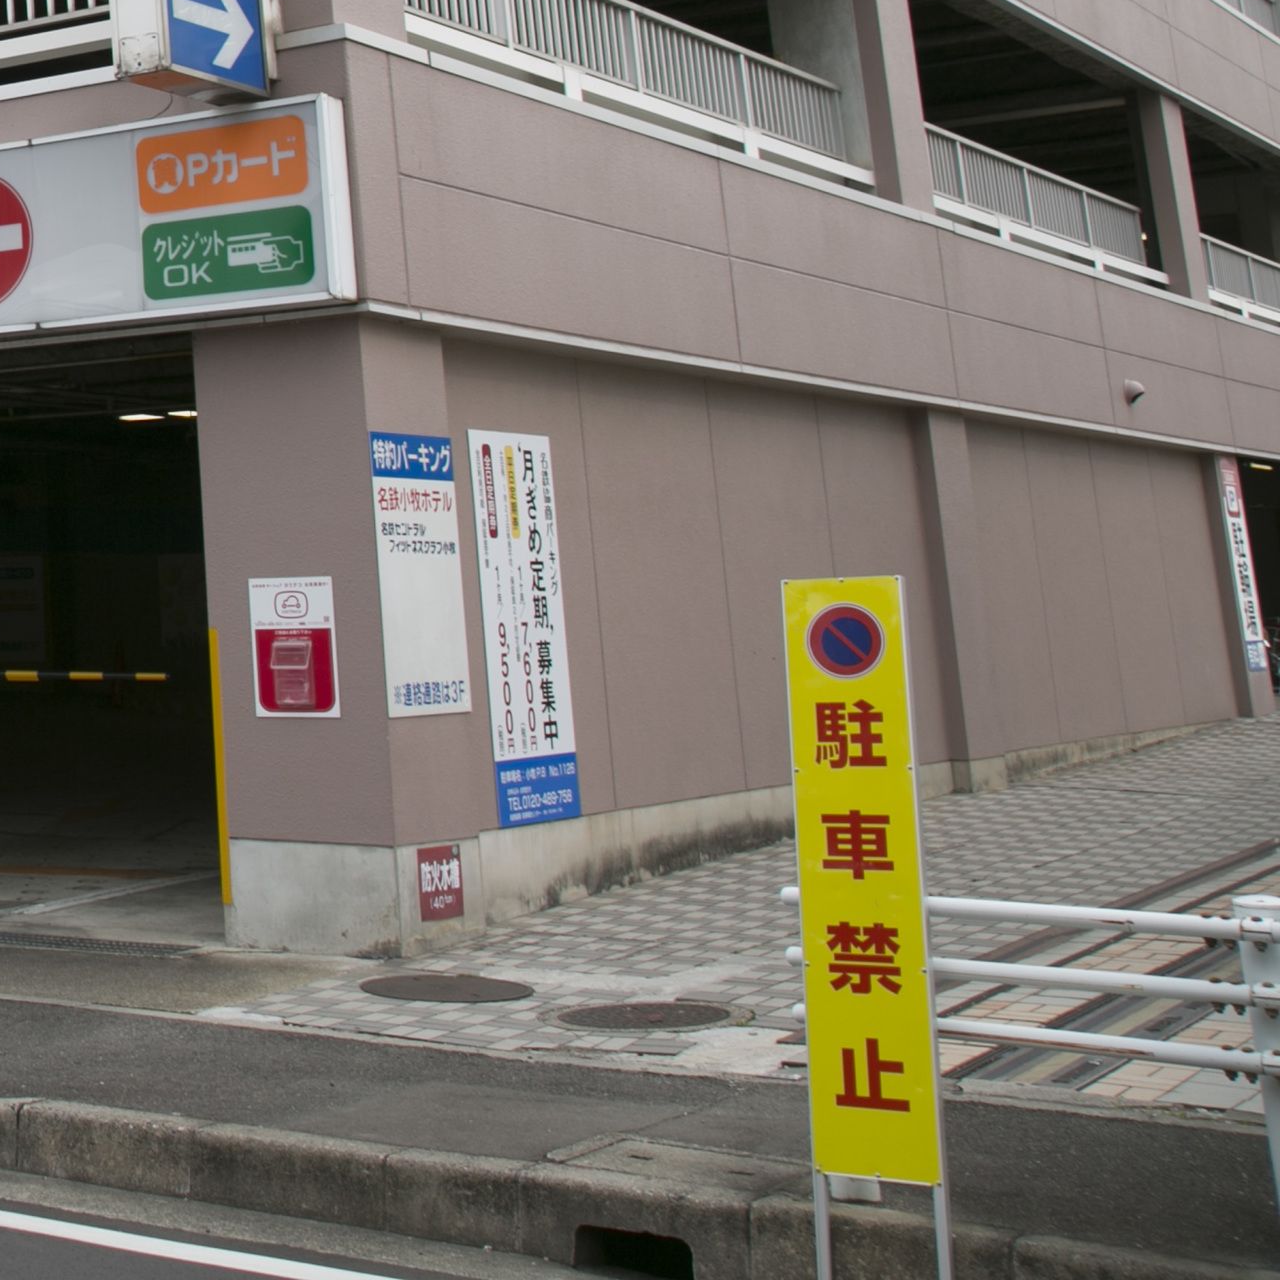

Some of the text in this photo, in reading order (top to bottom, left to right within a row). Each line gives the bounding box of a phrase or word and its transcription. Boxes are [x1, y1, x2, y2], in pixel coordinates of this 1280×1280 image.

[153, 230, 224, 262] クレジット
[163, 262, 213, 287] OK
[372, 438, 450, 472] 特約パーキング
[378, 487, 452, 512] 名鉄小牧ホテル
[420, 858, 460, 893] 防火水槽
[815, 699, 911, 1113] 駐車禁止
